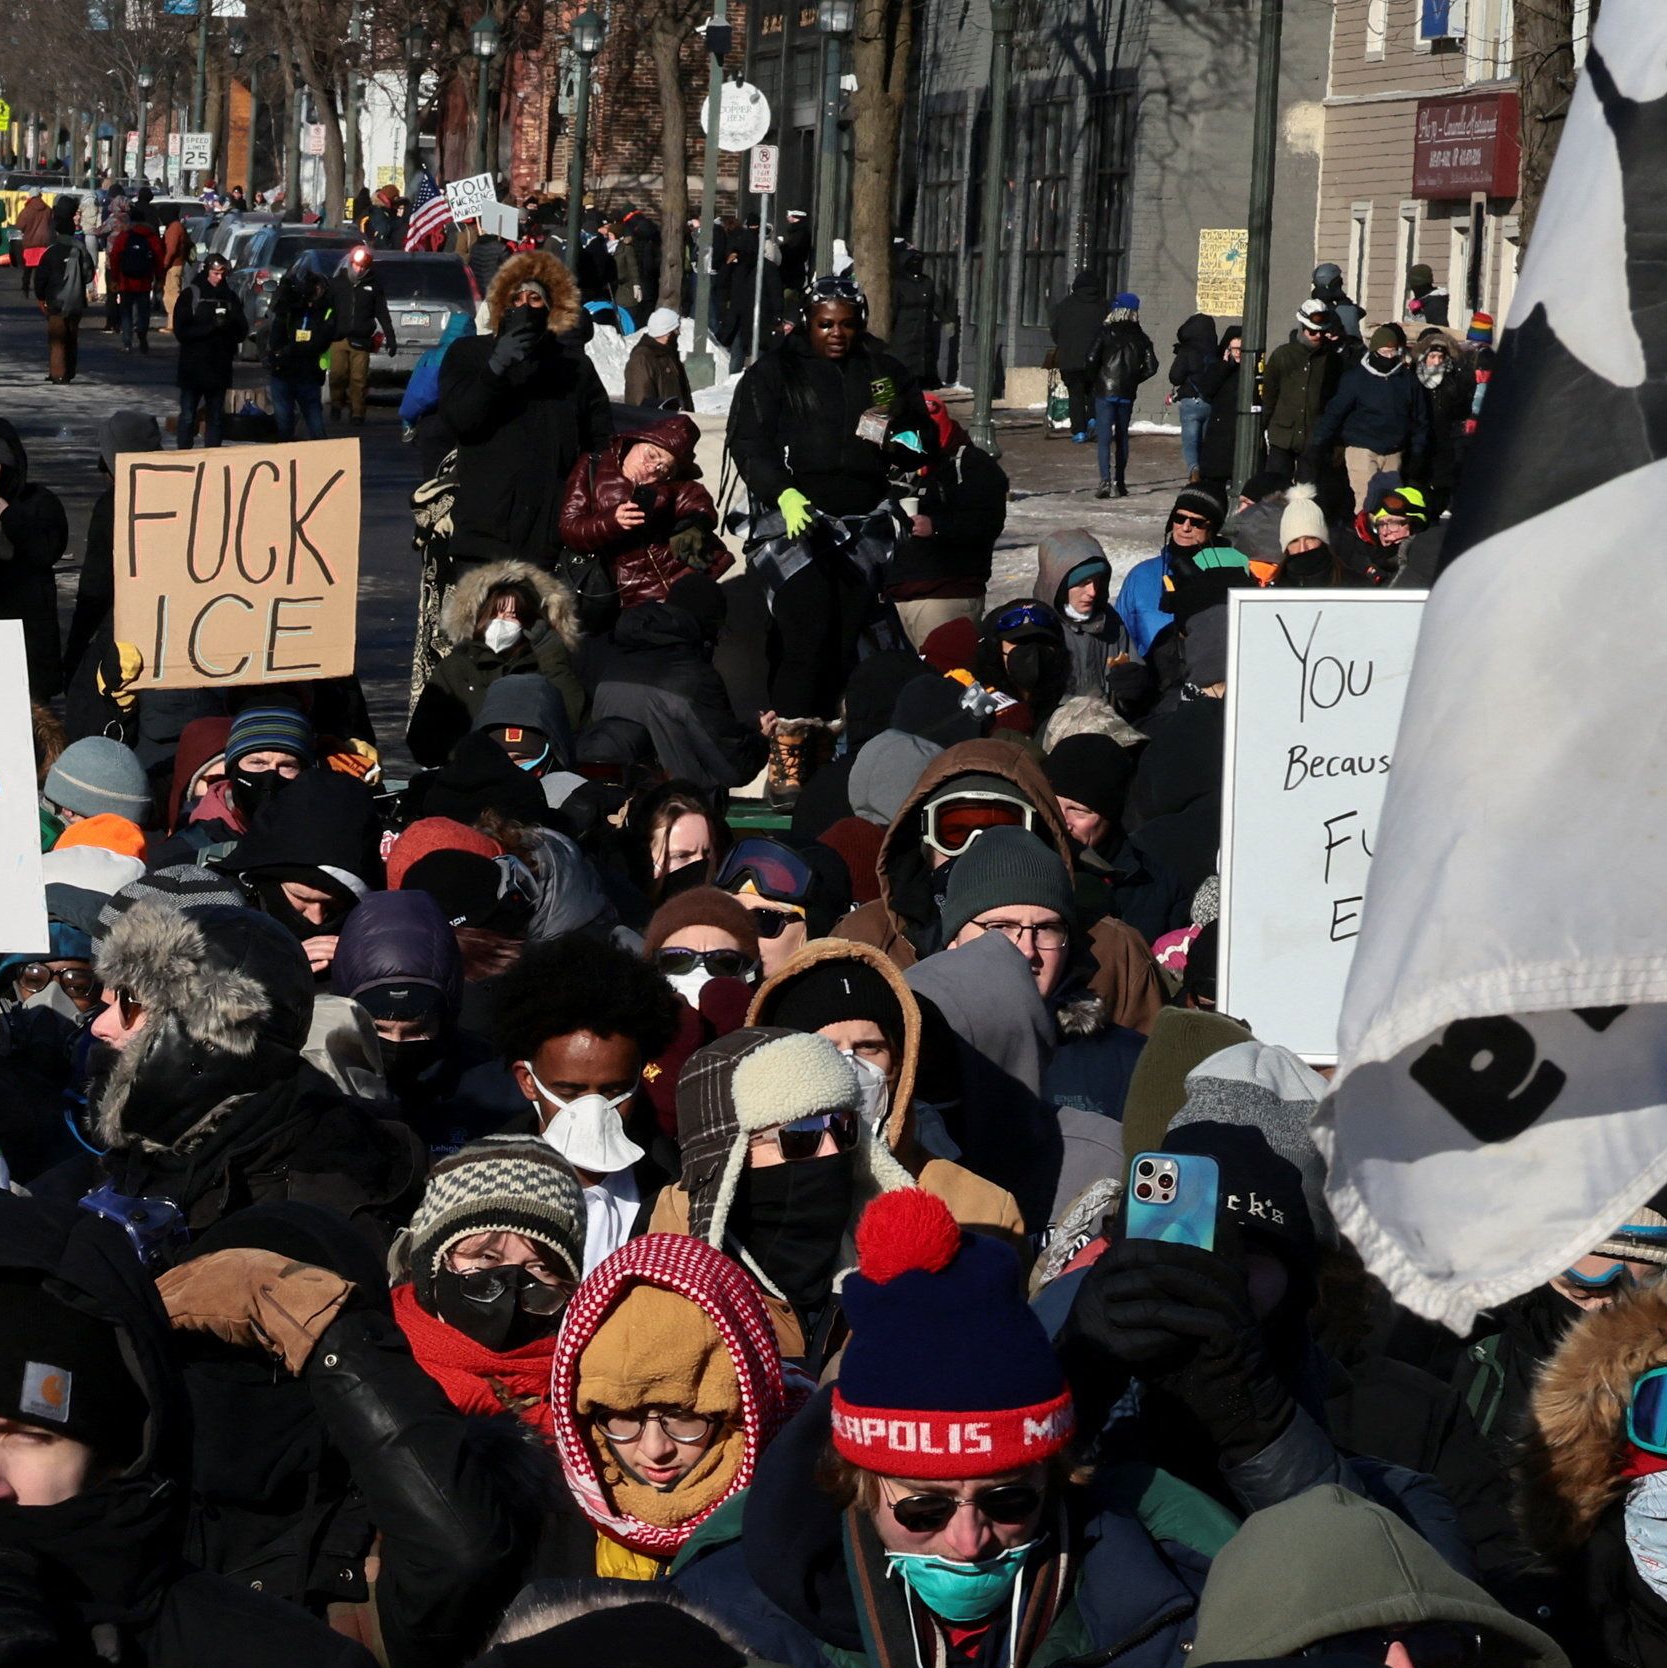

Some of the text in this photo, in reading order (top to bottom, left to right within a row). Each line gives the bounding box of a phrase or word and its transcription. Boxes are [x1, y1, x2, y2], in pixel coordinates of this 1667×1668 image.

[185, 151, 209, 166] 25
[451, 176, 491, 197] YOU
[127, 459, 347, 586] FUCK
[151, 593, 324, 684] ICE
[1283, 745, 1396, 792] Becaus
